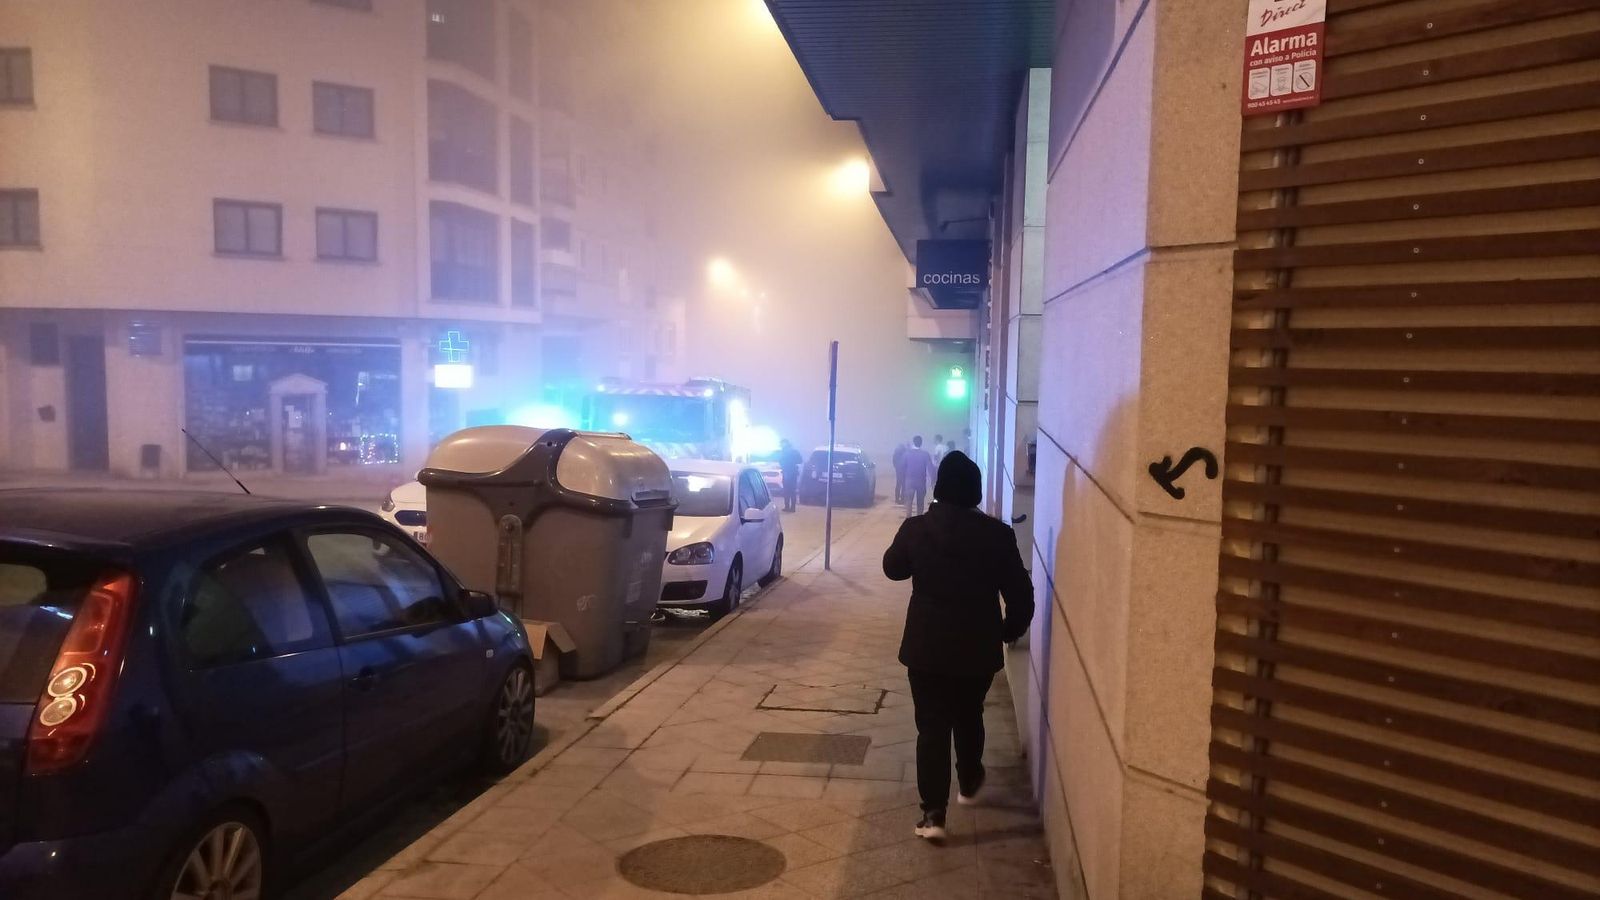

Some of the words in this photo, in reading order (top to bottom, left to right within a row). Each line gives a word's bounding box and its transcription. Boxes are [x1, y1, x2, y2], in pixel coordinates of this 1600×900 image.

[1250, 32, 1317, 57] Alarma
[1249, 57, 1263, 67] con
[1264, 54, 1284, 64] aviso
[923, 270, 980, 284] cocinas
